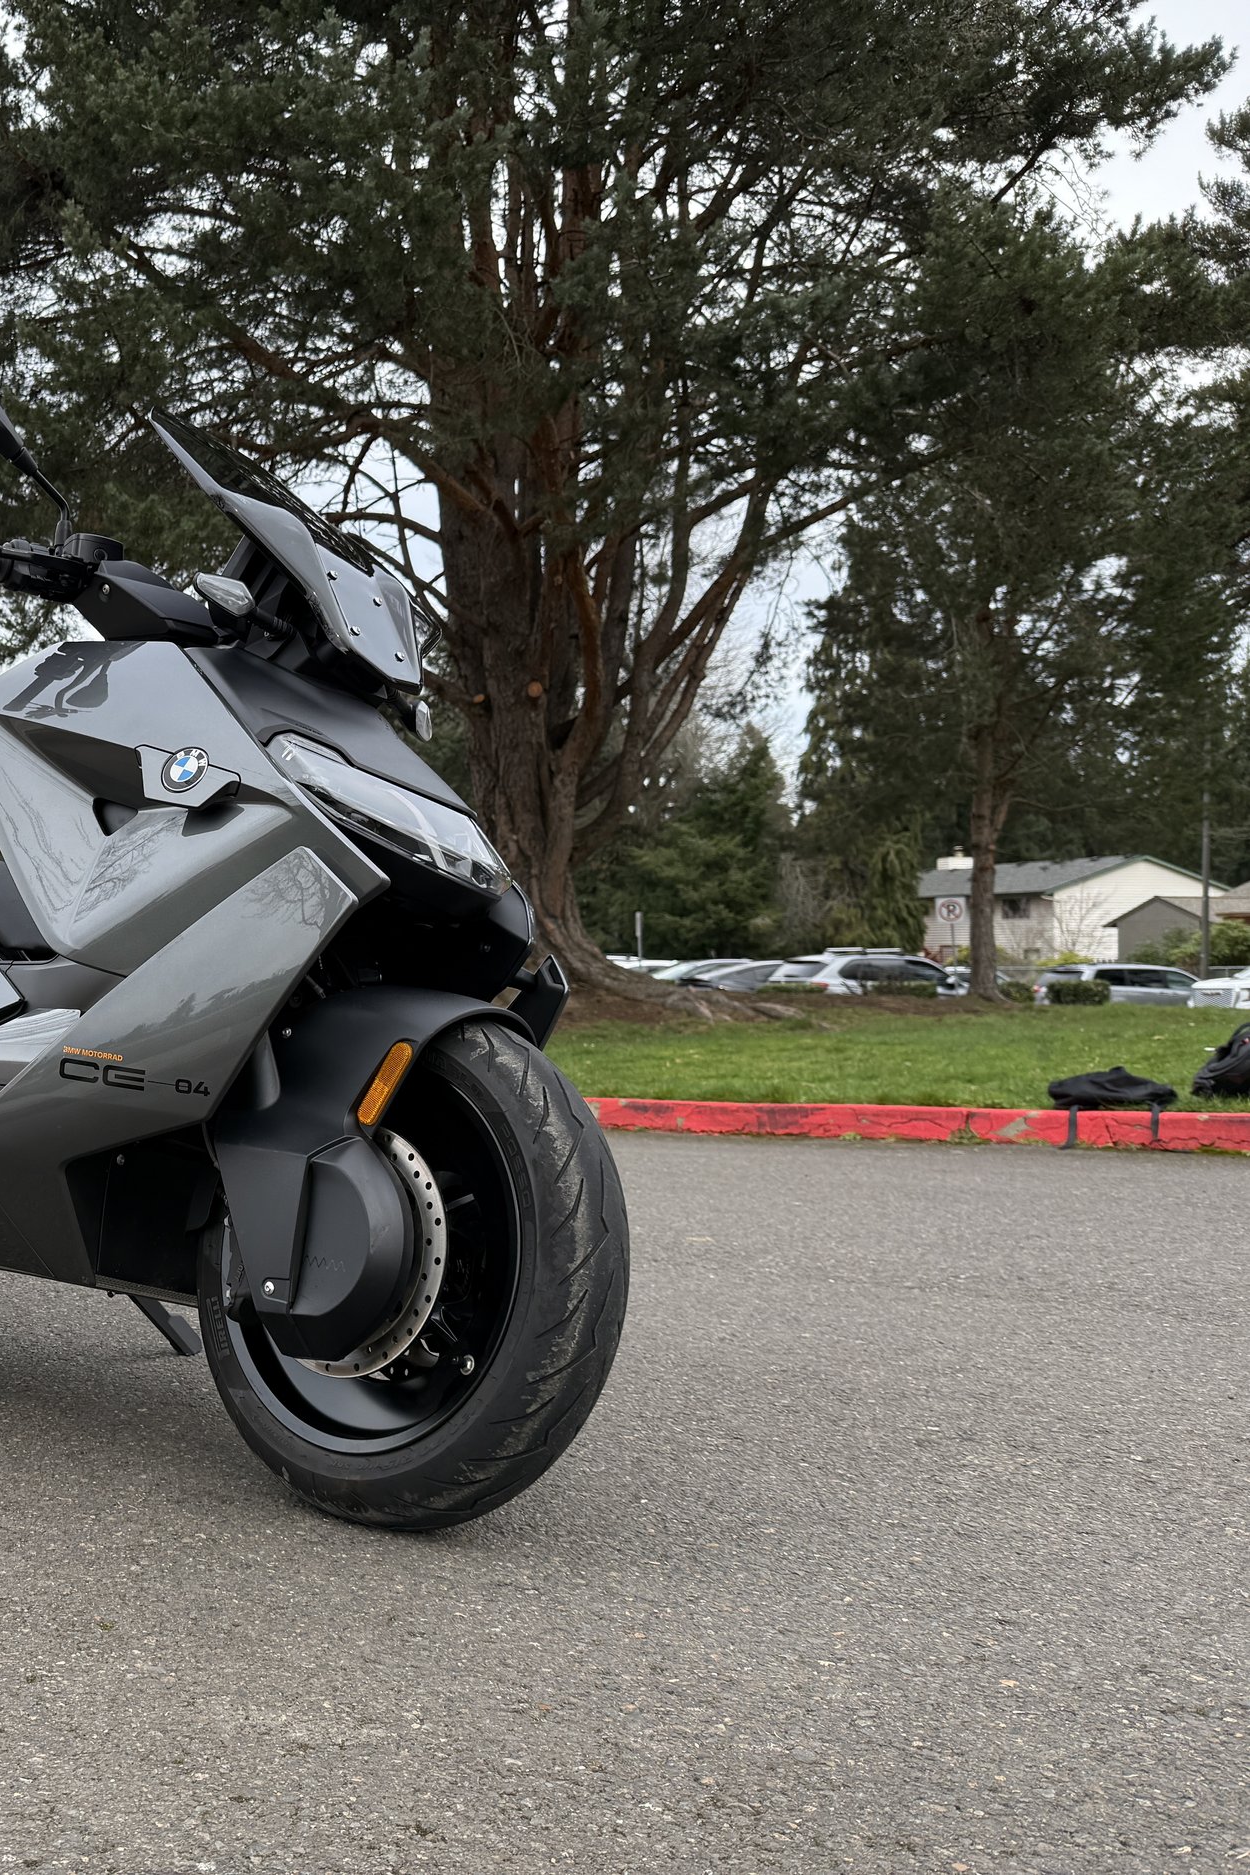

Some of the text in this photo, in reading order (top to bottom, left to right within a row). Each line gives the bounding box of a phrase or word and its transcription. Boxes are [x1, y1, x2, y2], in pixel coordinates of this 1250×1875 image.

[176, 749, 207, 766] BMW
[62, 1045, 124, 1062] BMW MOTORRAD
[59, 1057, 146, 1092] CE
[206, 1296, 230, 1360] PIRELLI
